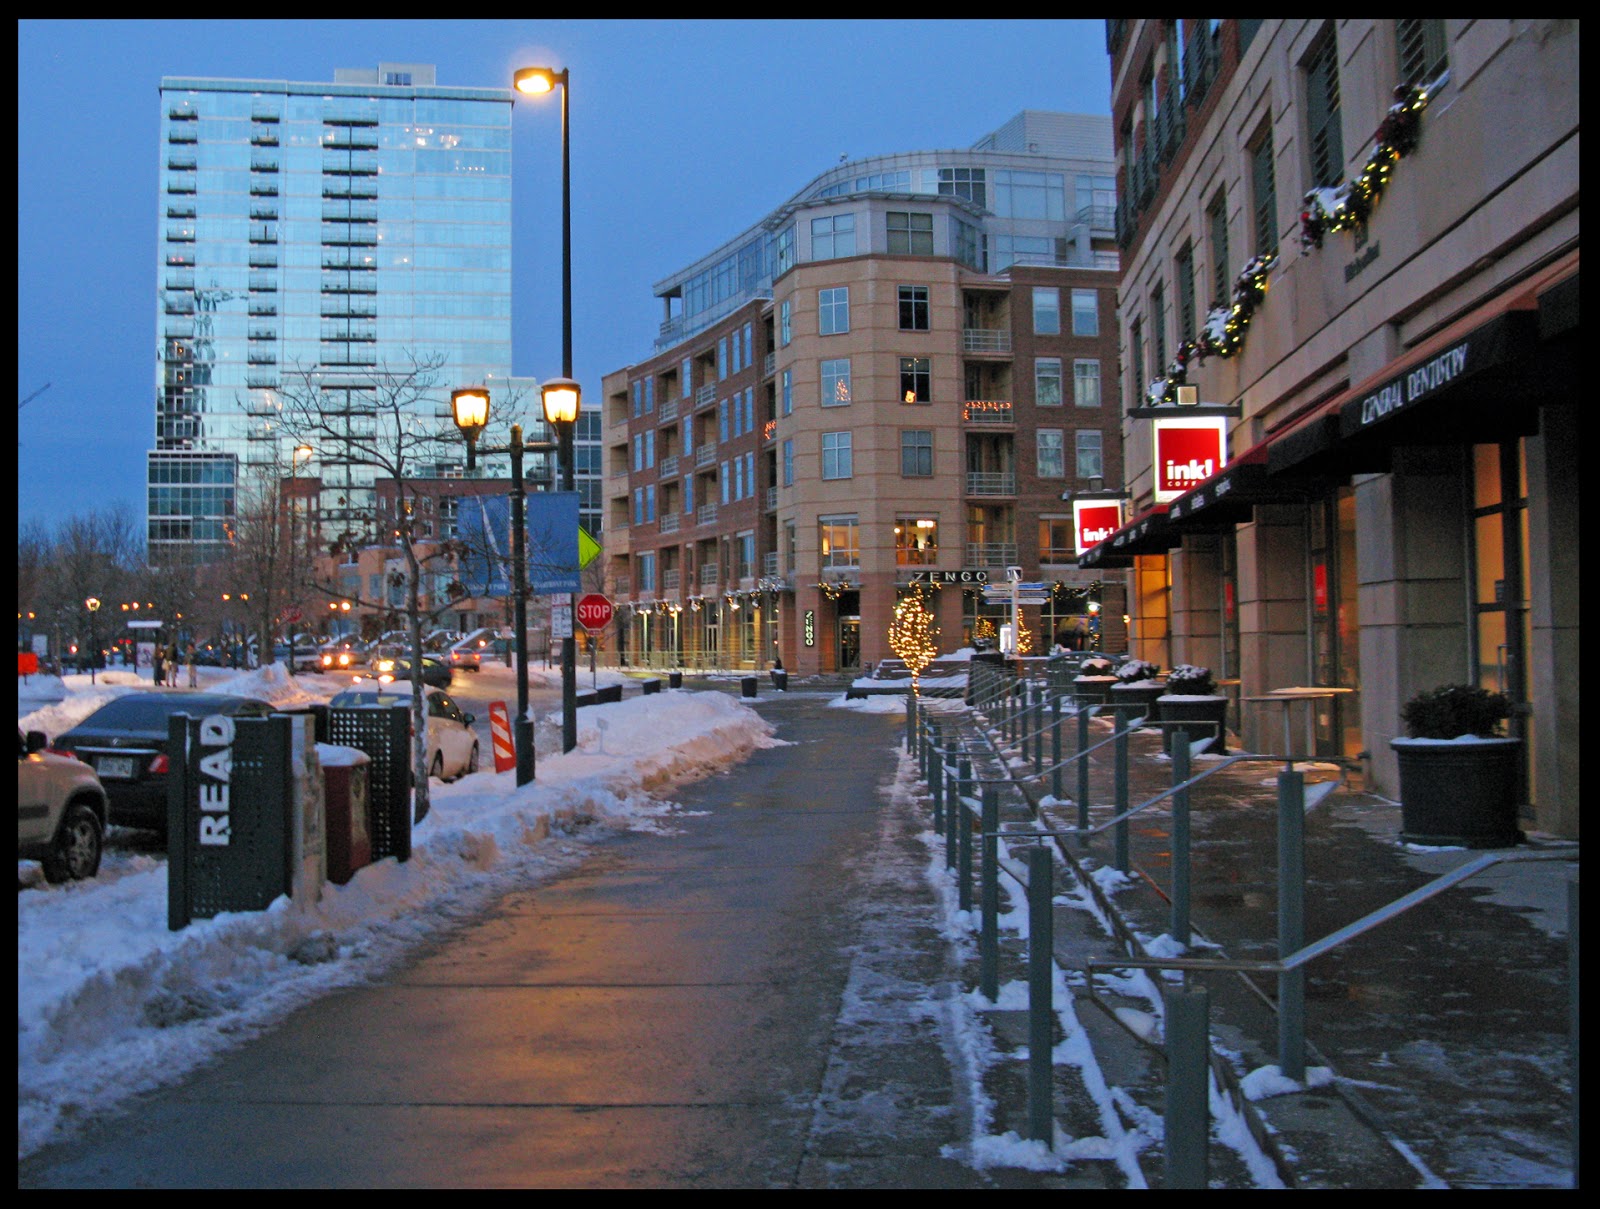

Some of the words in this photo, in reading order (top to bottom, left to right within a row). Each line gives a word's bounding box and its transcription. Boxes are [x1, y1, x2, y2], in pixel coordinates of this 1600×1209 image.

[1361, 380, 1403, 424] GENERAL
[1407, 343, 1469, 401] DENTISTRY
[1166, 459, 1213, 480] ink!
[913, 571, 988, 582] ZENGO
[578, 604, 610, 619] STOP
[805, 611, 815, 646] ZENGO
[199, 714, 236, 847] READ
